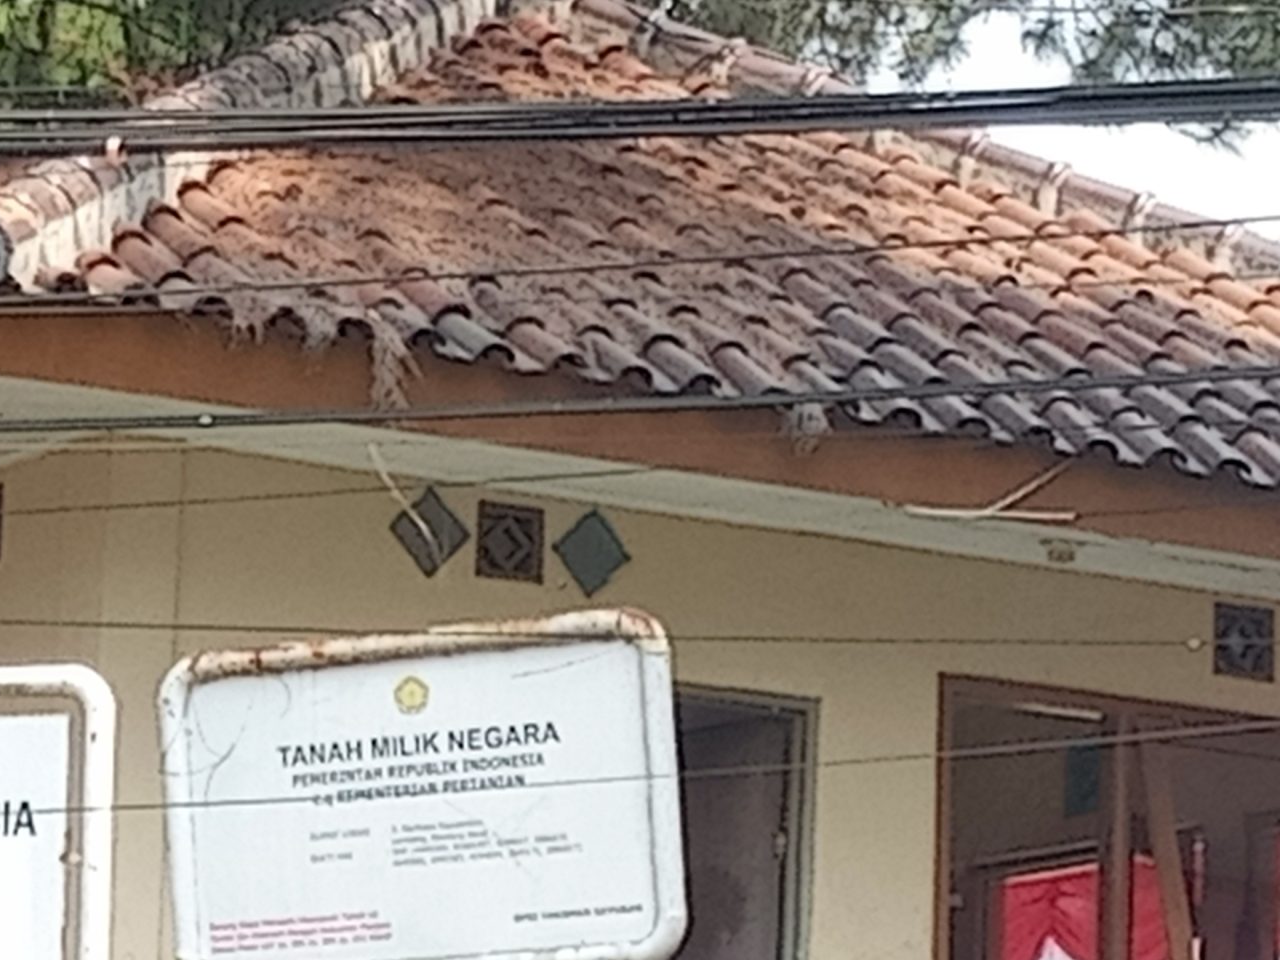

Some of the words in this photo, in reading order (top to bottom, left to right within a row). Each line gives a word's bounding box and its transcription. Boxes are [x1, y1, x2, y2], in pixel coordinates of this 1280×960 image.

[277, 739, 363, 768] TANAH
[371, 731, 441, 759] MILIK
[447, 721, 561, 753] NEGARA
